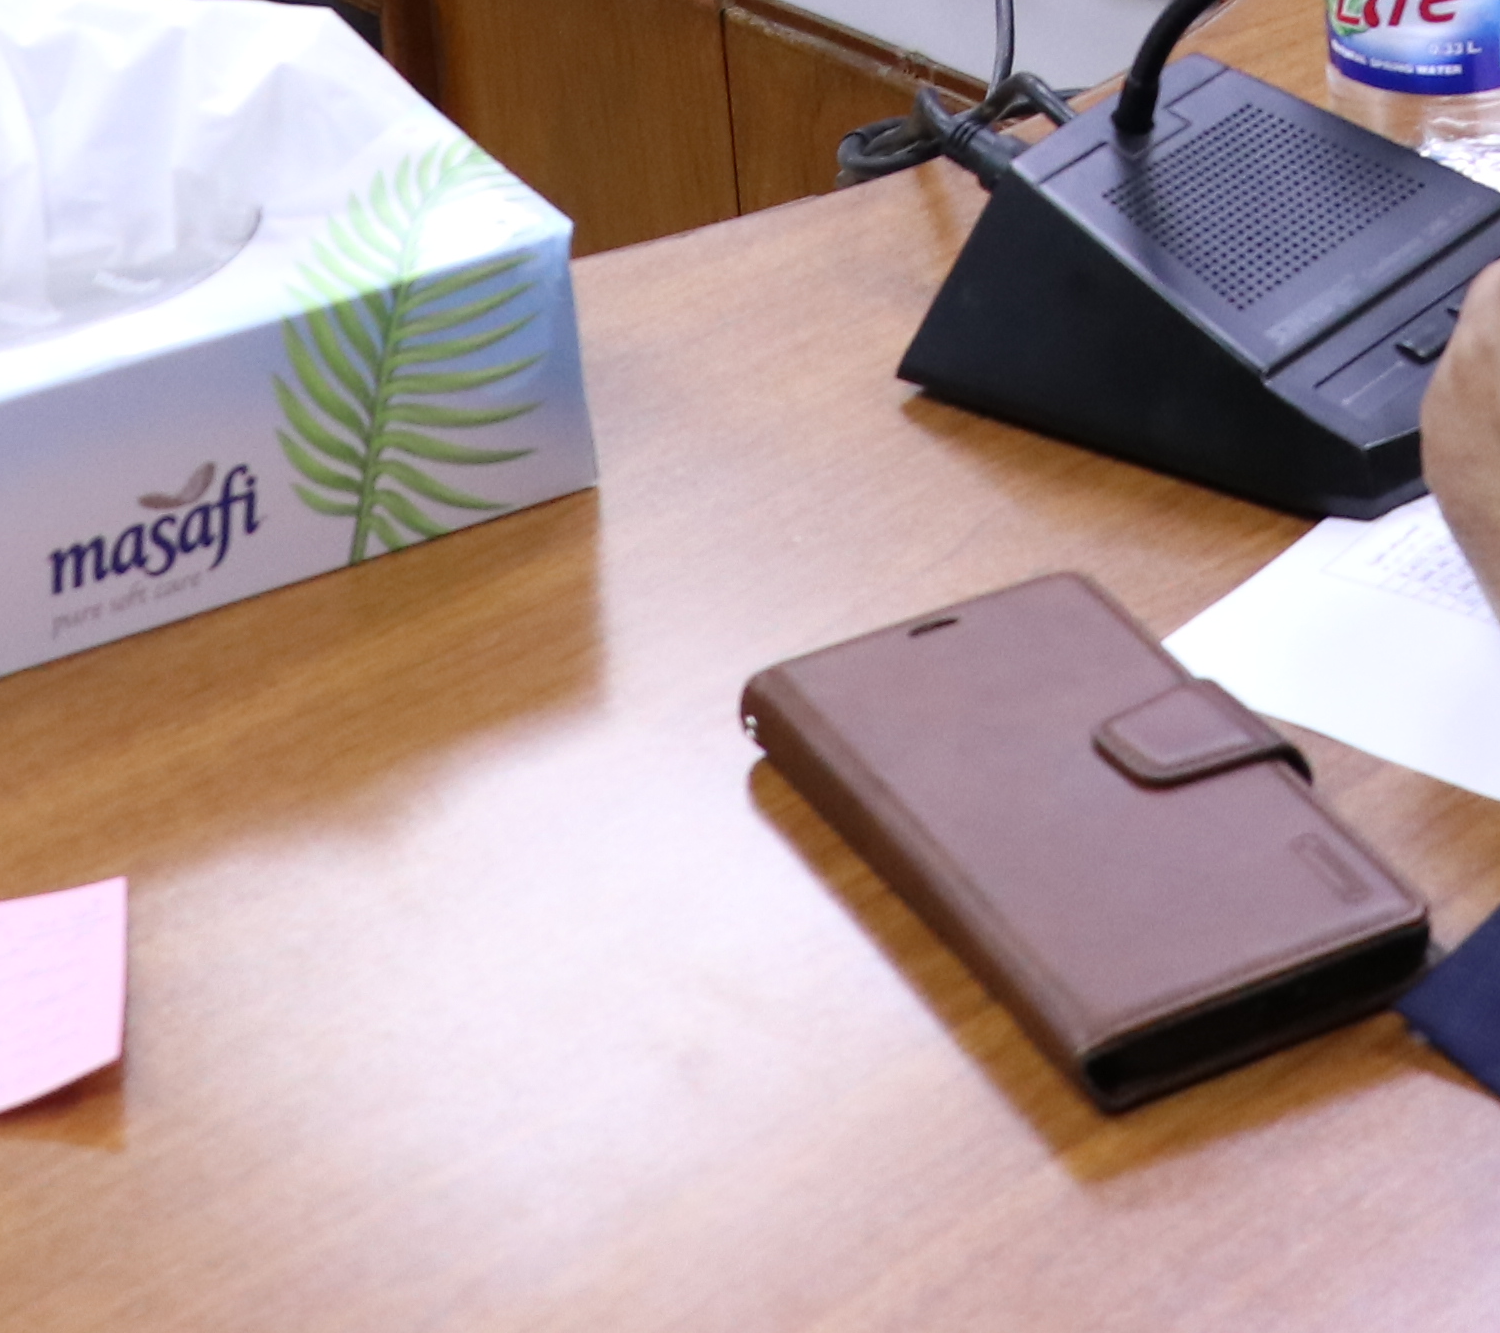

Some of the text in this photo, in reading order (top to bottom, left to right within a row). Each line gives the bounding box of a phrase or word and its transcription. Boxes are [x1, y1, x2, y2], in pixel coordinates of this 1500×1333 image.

[1415, 64, 1463, 75] WATER
[49, 463, 258, 595] masafi
[52, 602, 102, 640] pure
